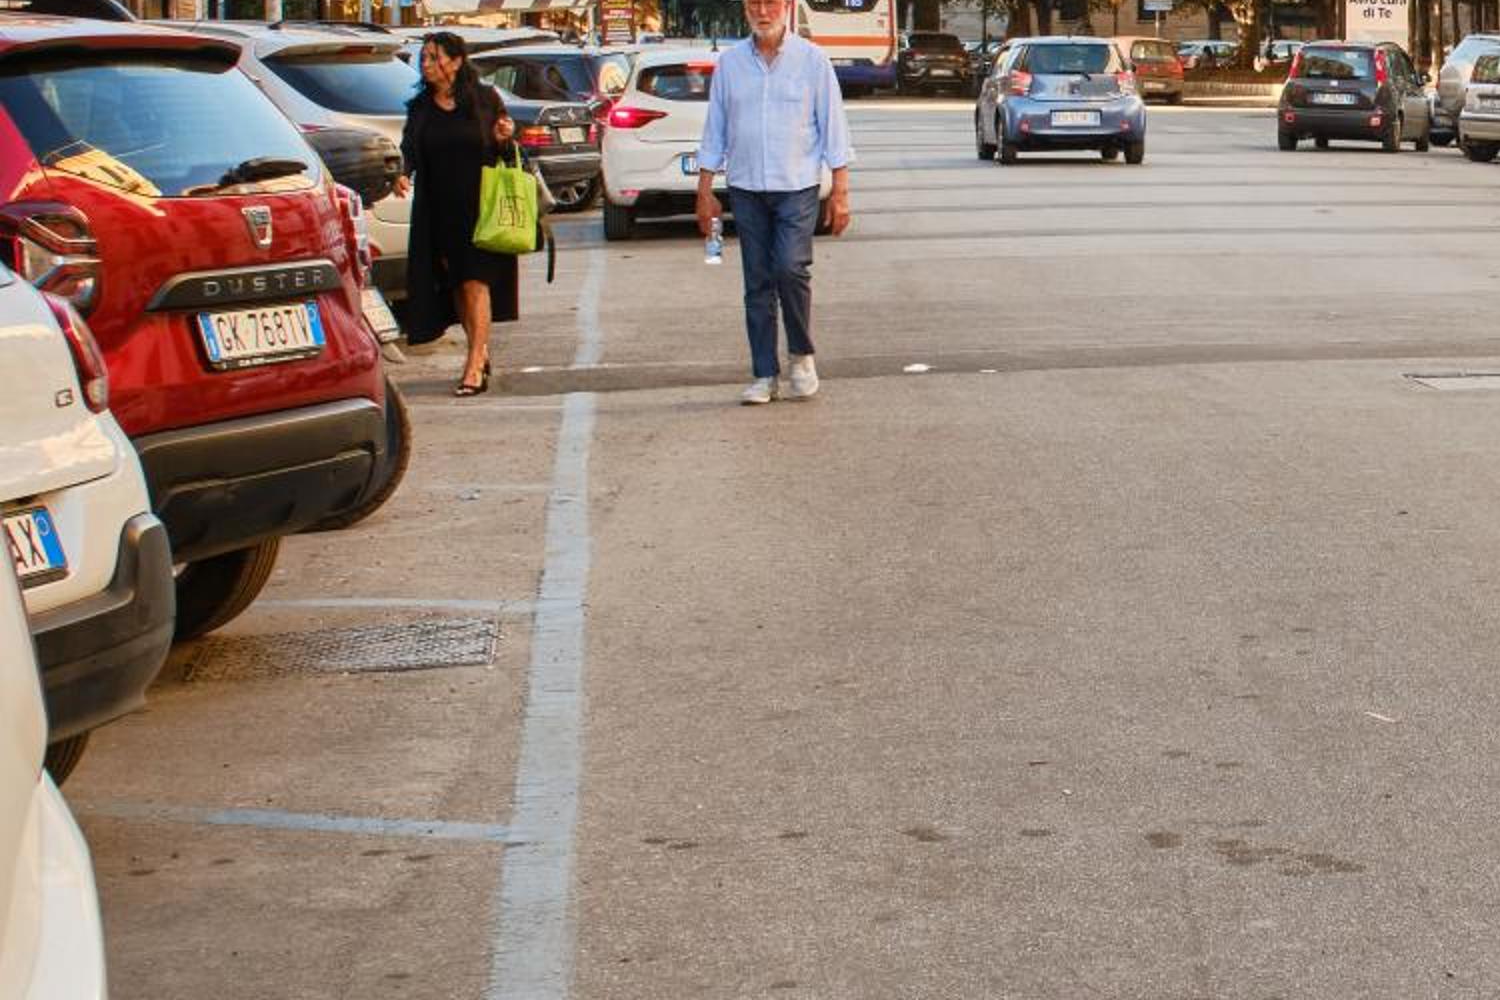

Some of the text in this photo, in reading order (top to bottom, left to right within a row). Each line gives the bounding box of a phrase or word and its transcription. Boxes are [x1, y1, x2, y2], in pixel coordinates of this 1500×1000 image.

[1363, 7, 1393, 19] di Te
[203, 269, 324, 297] DUSTER
[217, 309, 310, 351] GK 768TV
